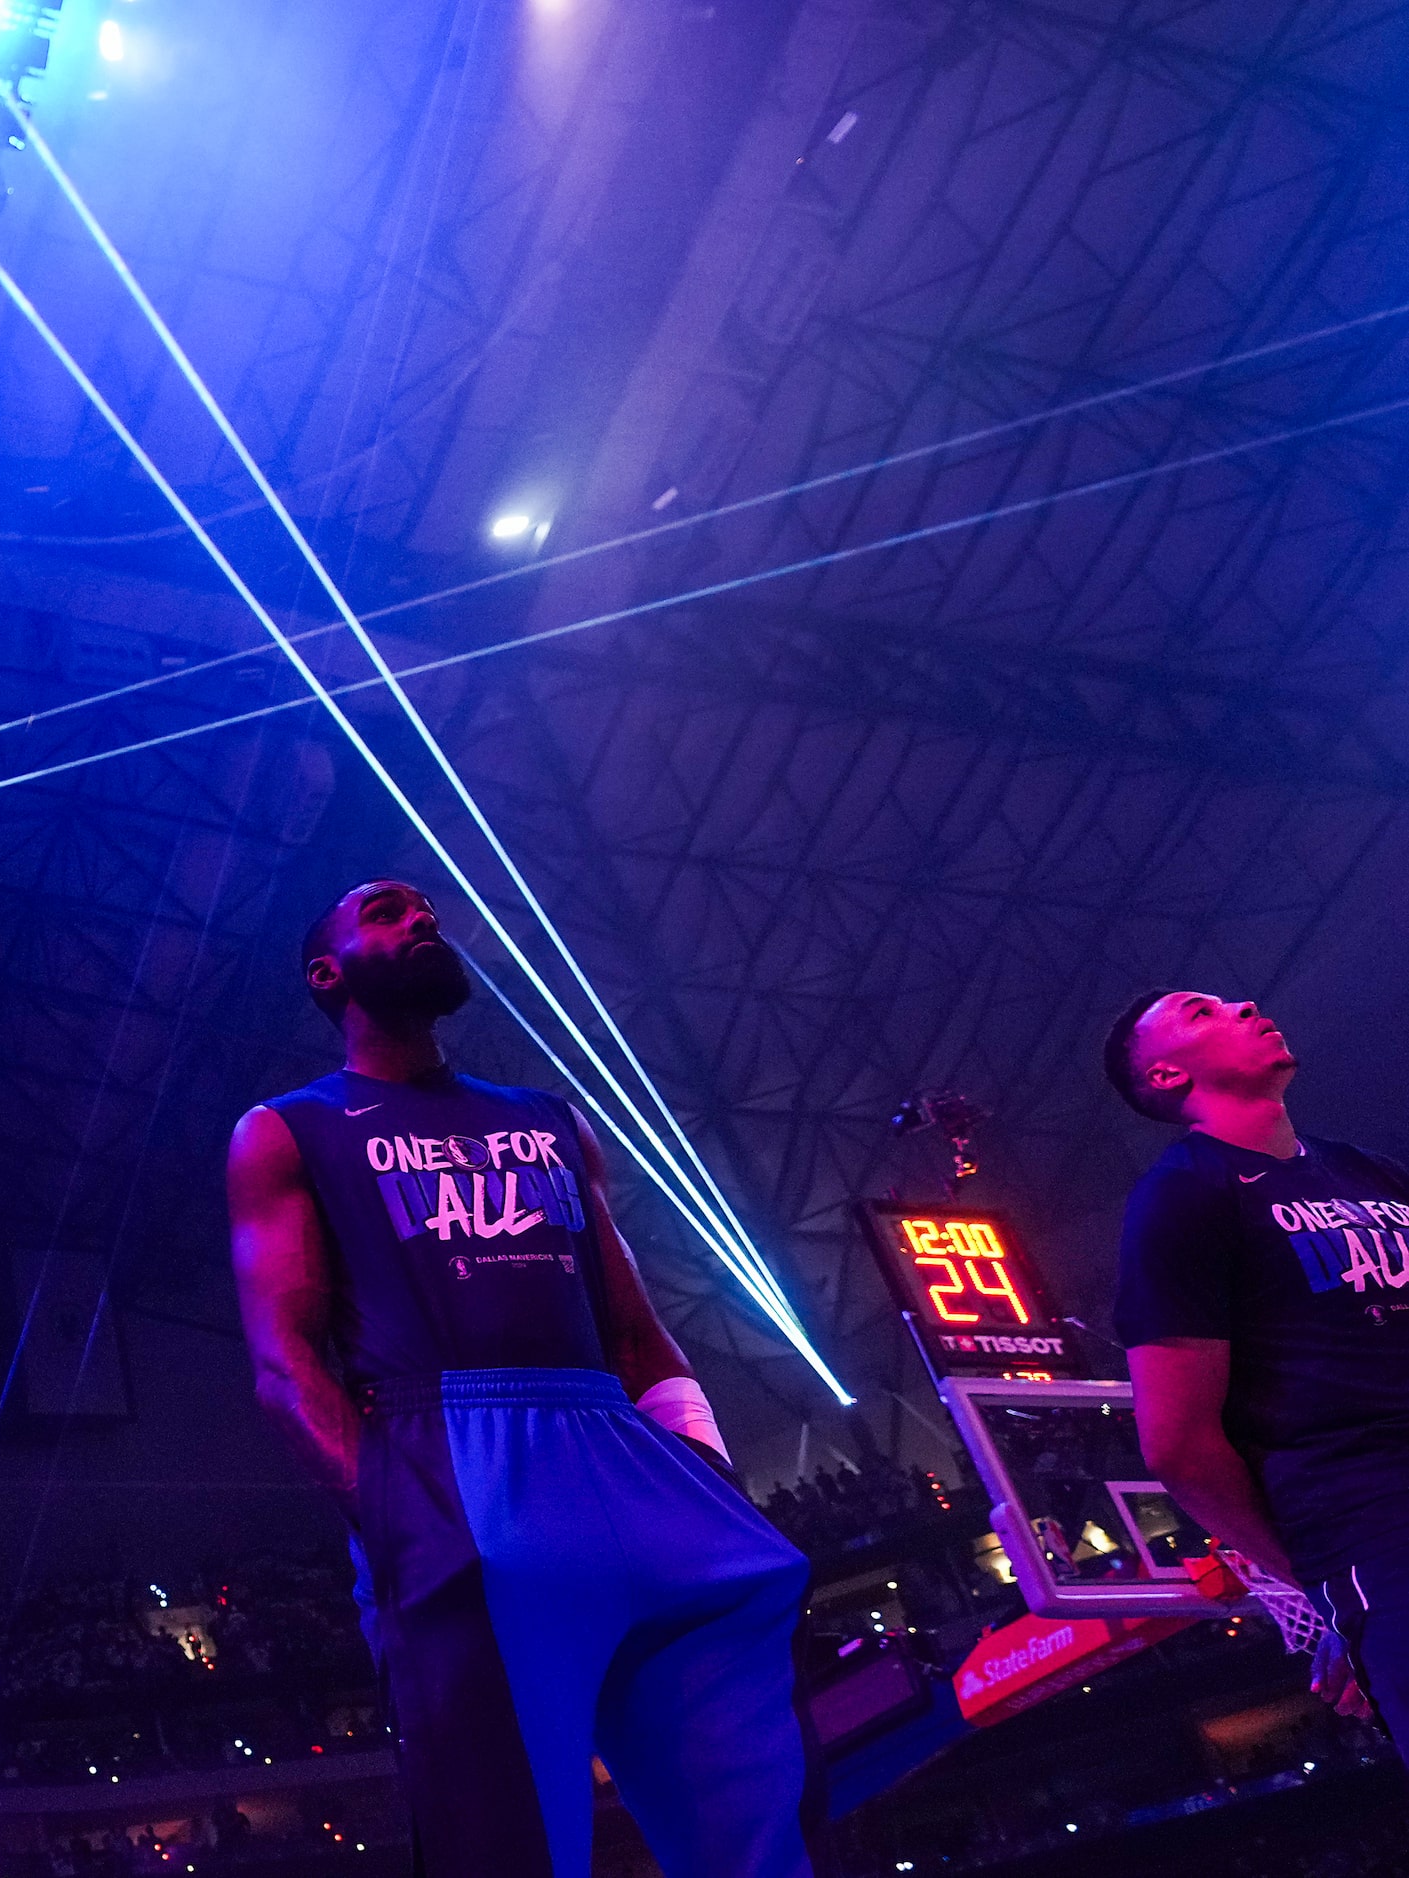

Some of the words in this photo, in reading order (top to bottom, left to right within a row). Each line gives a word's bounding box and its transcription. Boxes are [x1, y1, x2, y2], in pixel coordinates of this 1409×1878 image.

[367, 1132, 454, 1173] ONE
[483, 1129, 566, 1170] FOR
[425, 1172, 546, 1240] ALL
[1272, 1199, 1349, 1232] ONE
[475, 1254, 509, 1264] DALLAS
[509, 1253, 554, 1262] MAVERICKS
[901, 1219, 1005, 1259] 12:00
[914, 1256, 1030, 1325] 24
[973, 1335, 1064, 1355] TISSOT
